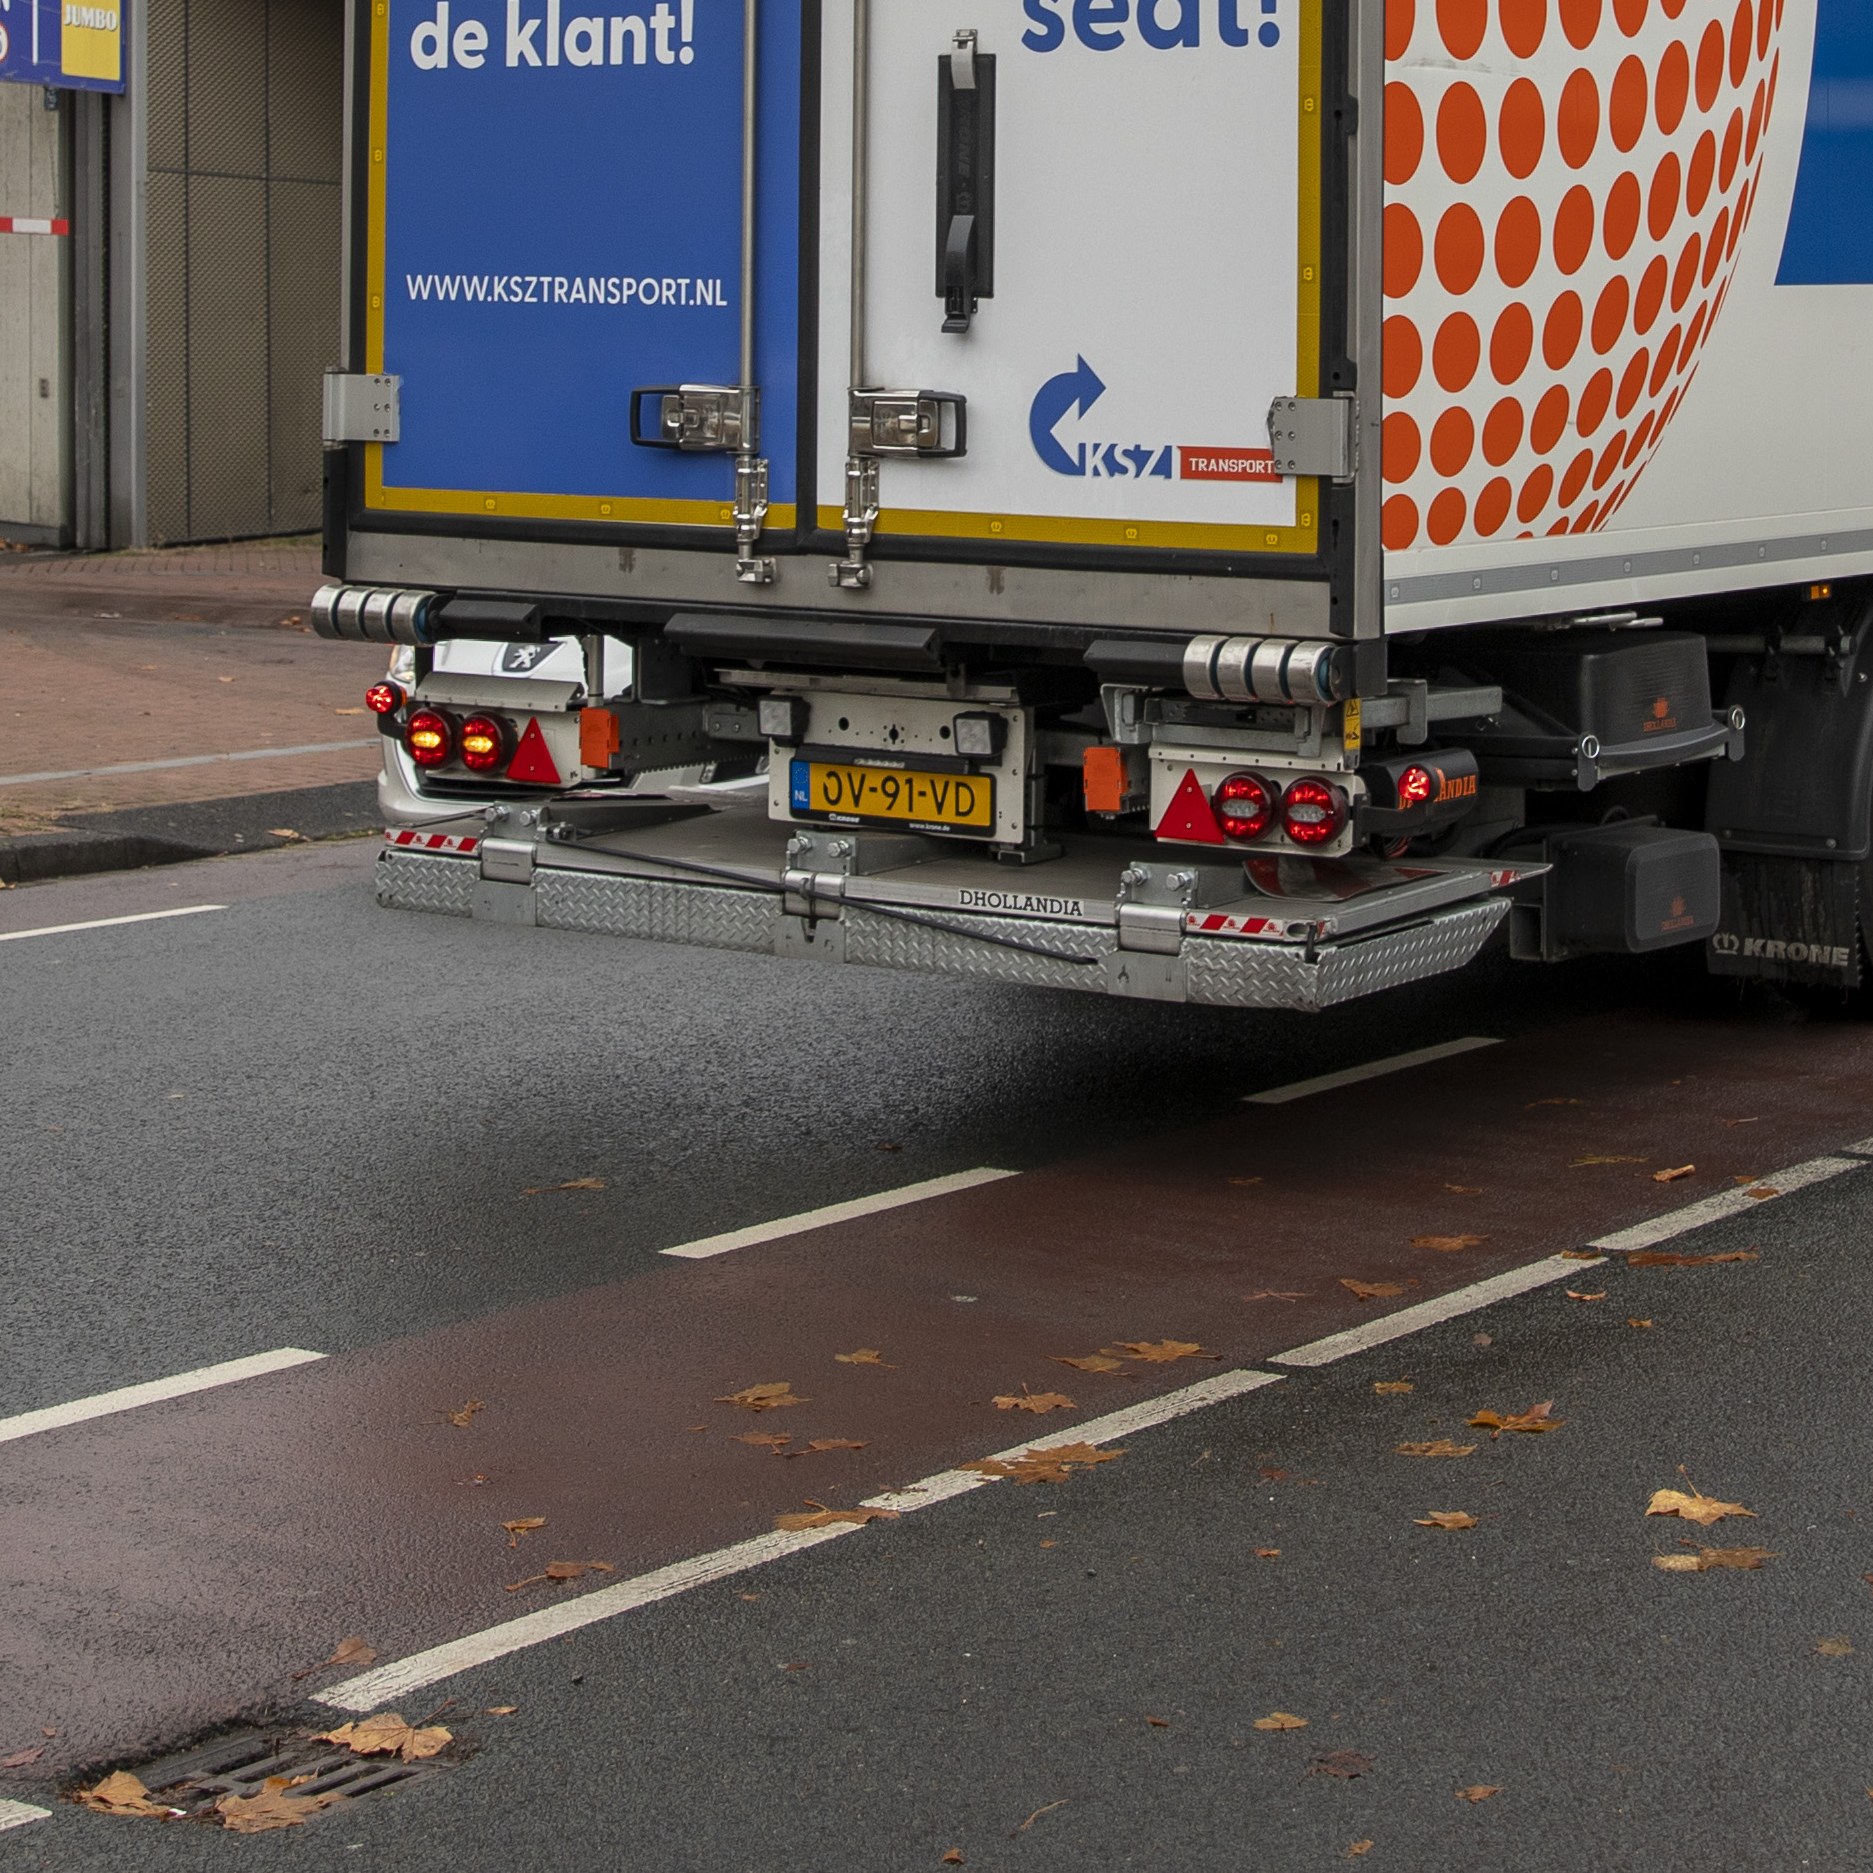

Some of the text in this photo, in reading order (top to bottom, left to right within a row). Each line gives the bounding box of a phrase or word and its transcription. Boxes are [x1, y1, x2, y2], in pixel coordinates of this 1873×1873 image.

[63, 4, 118, 32] JUMBO
[410, 0, 489, 69] de
[406, 274, 727, 306] WWW.KSZTRANSPORT.NL
[1189, 457, 1275, 474] TRANSPORT
[794, 789, 808, 802] NL
[822, 770, 975, 817] OV-91-VD
[959, 889, 1083, 917] DHOLLANDIA
[1742, 937, 1851, 967] KRONE
